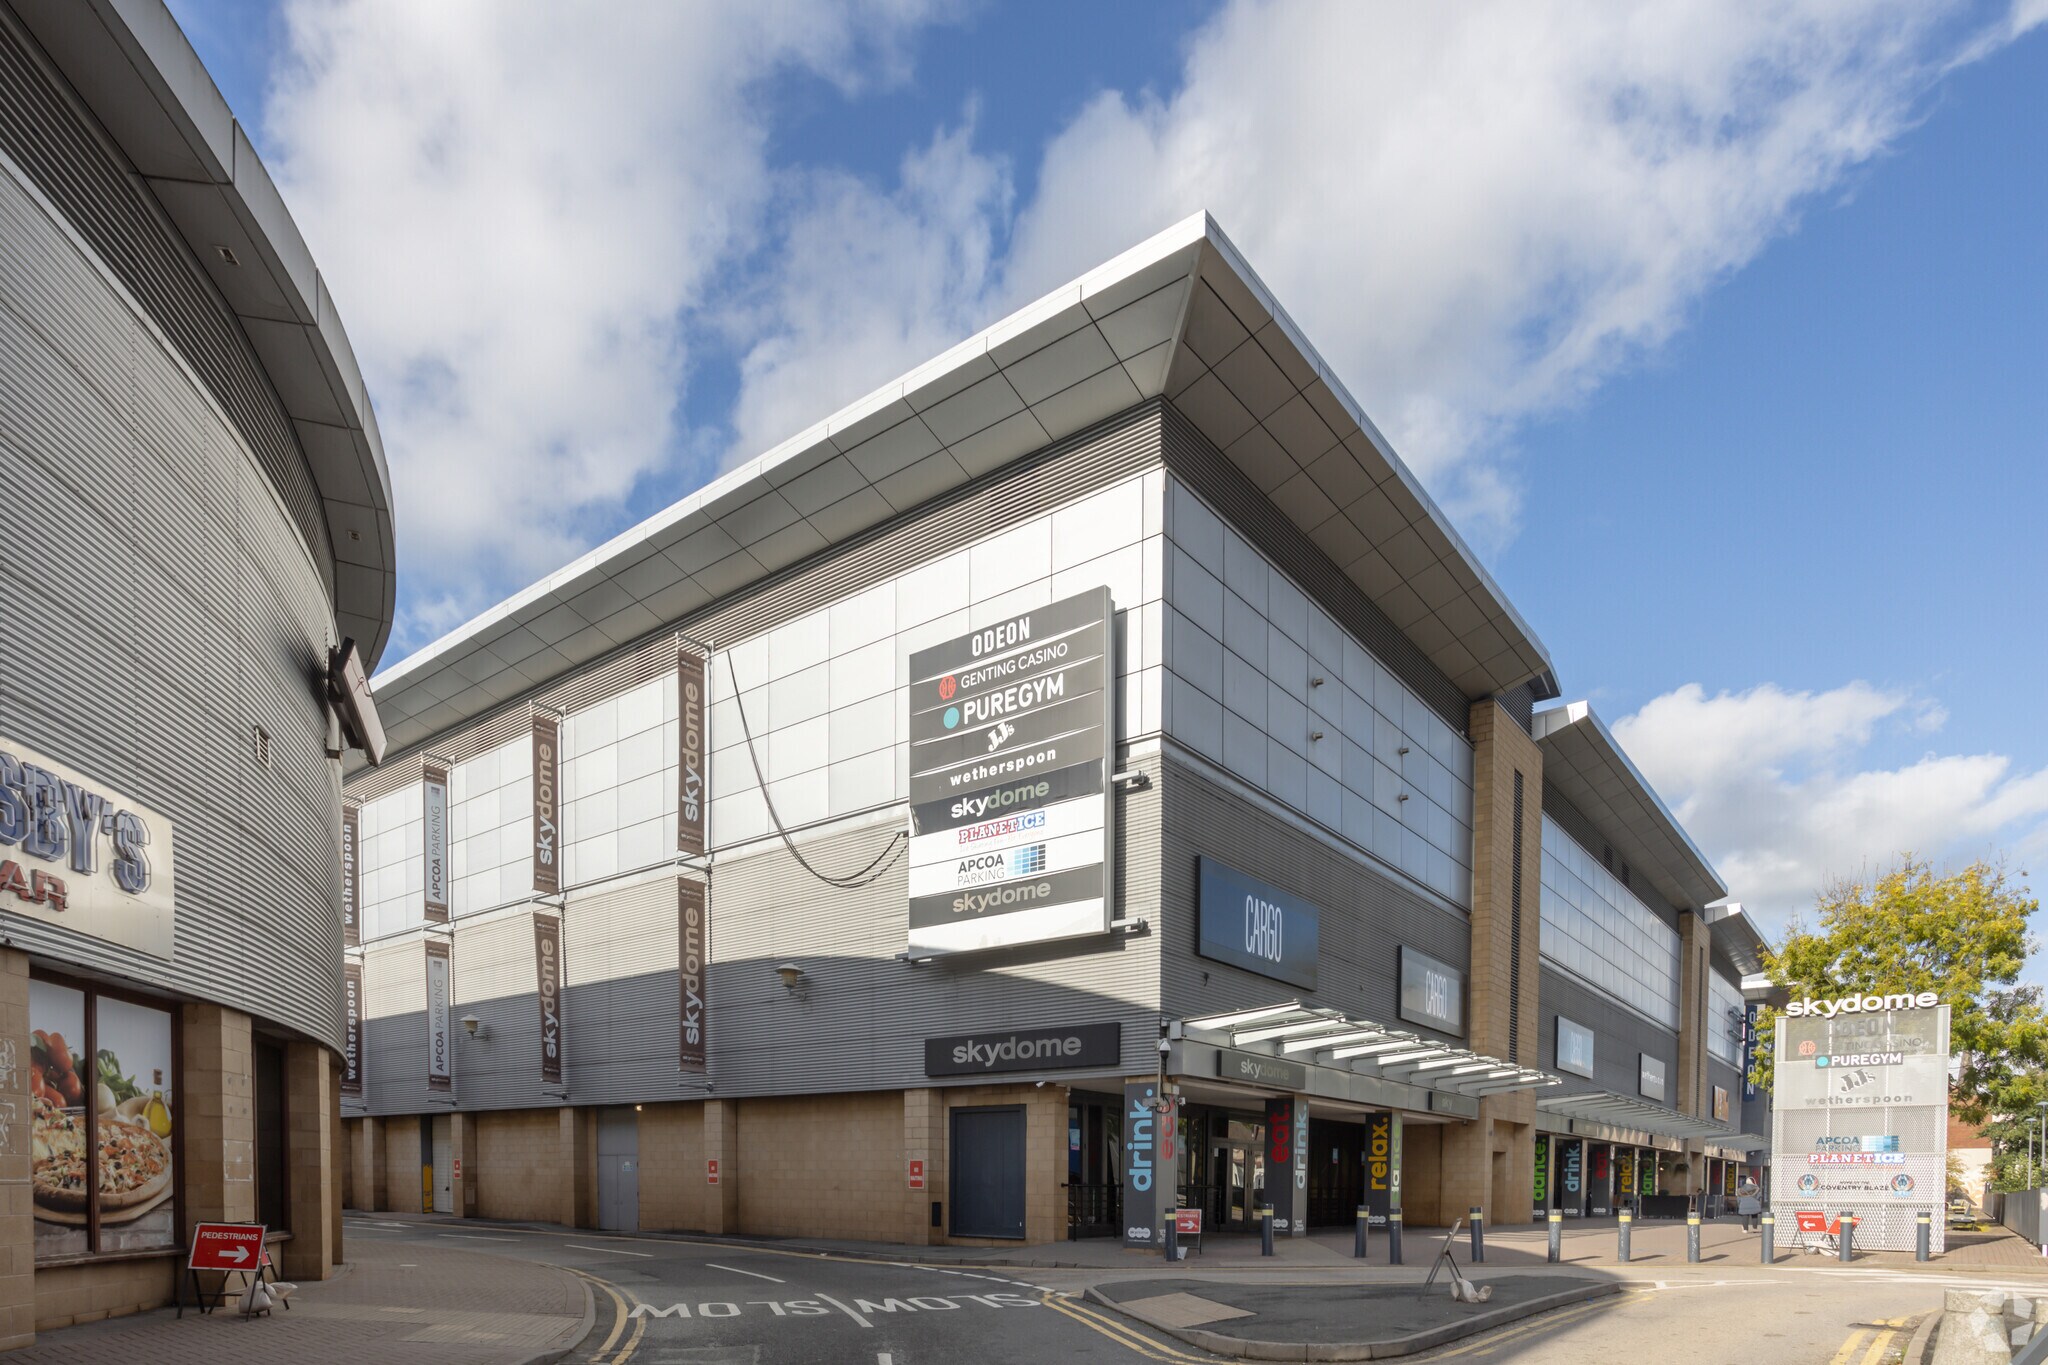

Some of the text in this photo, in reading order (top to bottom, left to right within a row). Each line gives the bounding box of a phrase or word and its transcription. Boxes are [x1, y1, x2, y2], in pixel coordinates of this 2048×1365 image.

[972, 616, 1031, 657] ODEON
[960, 642, 1068, 689] GENTING CASINO
[963, 672, 1064, 725] PUREGYM
[682, 682, 702, 822] skydome
[950, 748, 1056, 786] wetherspoon
[536, 743, 556, 865] skydome
[951, 781, 1050, 818] skydome
[431, 805, 441, 856] PARKING
[343, 824, 354, 925] wetherspoon
[431, 858, 441, 900] APCOA
[957, 867, 1005, 887] PARKING
[958, 854, 1004, 874] APCOA
[952, 882, 1051, 913] skydome
[1245, 894, 1283, 963] CARGO
[682, 907, 703, 1045] skydome
[1425, 970, 1448, 1020] CARGO
[433, 979, 443, 1029] PARKING
[541, 938, 559, 1058] skydome
[1786, 992, 1938, 1019] skydome
[346, 980, 358, 1080] wetherspoon
[435, 1031, 444, 1072] APCOA
[952, 1036, 1082, 1067] skydome
[1240, 1057, 1290, 1080] skydome
[1831, 1052, 1902, 1067] PUREGYM
[1805, 1094, 1913, 1106] wetherspoon
[1127, 1088, 1153, 1192] drink.
[1270, 1103, 1290, 1164] eat.
[1294, 1104, 1307, 1190] drink.
[1367, 1116, 1389, 1190] relax.
[1815, 1144, 1862, 1153] PARKING
[1816, 1136, 1860, 1145] APCOA
[1564, 1142, 1580, 1193] drink.
[201, 1231, 259, 1241] PEDESTRIANS
[627, 1300, 830, 1318] SLOW
[853, 1293, 1041, 1313] SLOW
